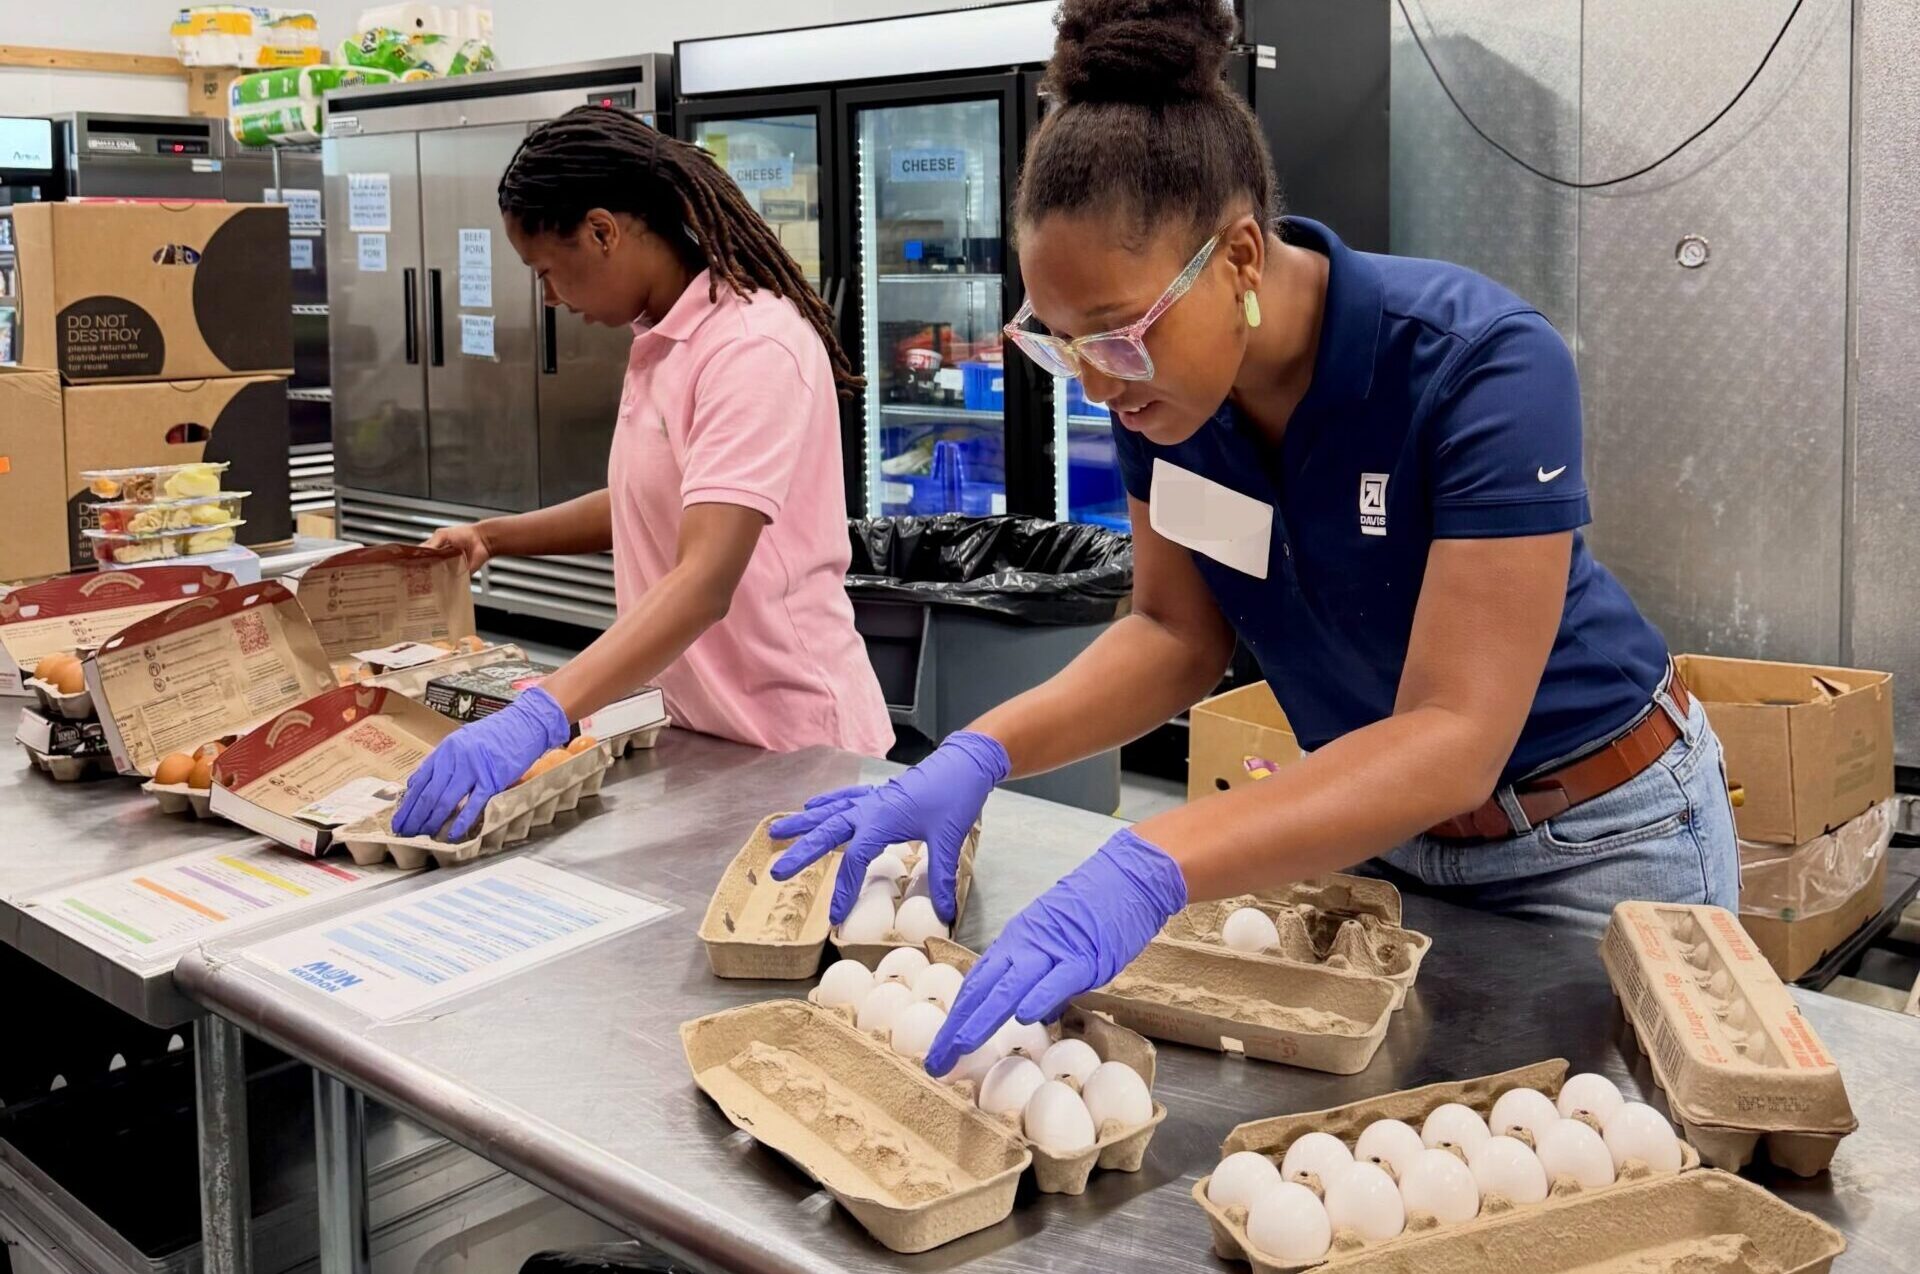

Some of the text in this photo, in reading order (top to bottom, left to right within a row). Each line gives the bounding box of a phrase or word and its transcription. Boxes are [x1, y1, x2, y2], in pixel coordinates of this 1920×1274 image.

[901, 157, 956, 173] CHEESE
[736, 168, 783, 182] CHEESE
[464, 245, 485, 254] PORK
[68, 315, 128, 328] DO NOT
[68, 328, 141, 342] DESTROY
[68, 344, 97, 353] please
[68, 353, 118, 361] distribution
[68, 363, 81, 371] for
[1360, 515, 1386, 526] DAVIS
[288, 967, 341, 992] NOURISH
[302, 961, 364, 987] NOW
